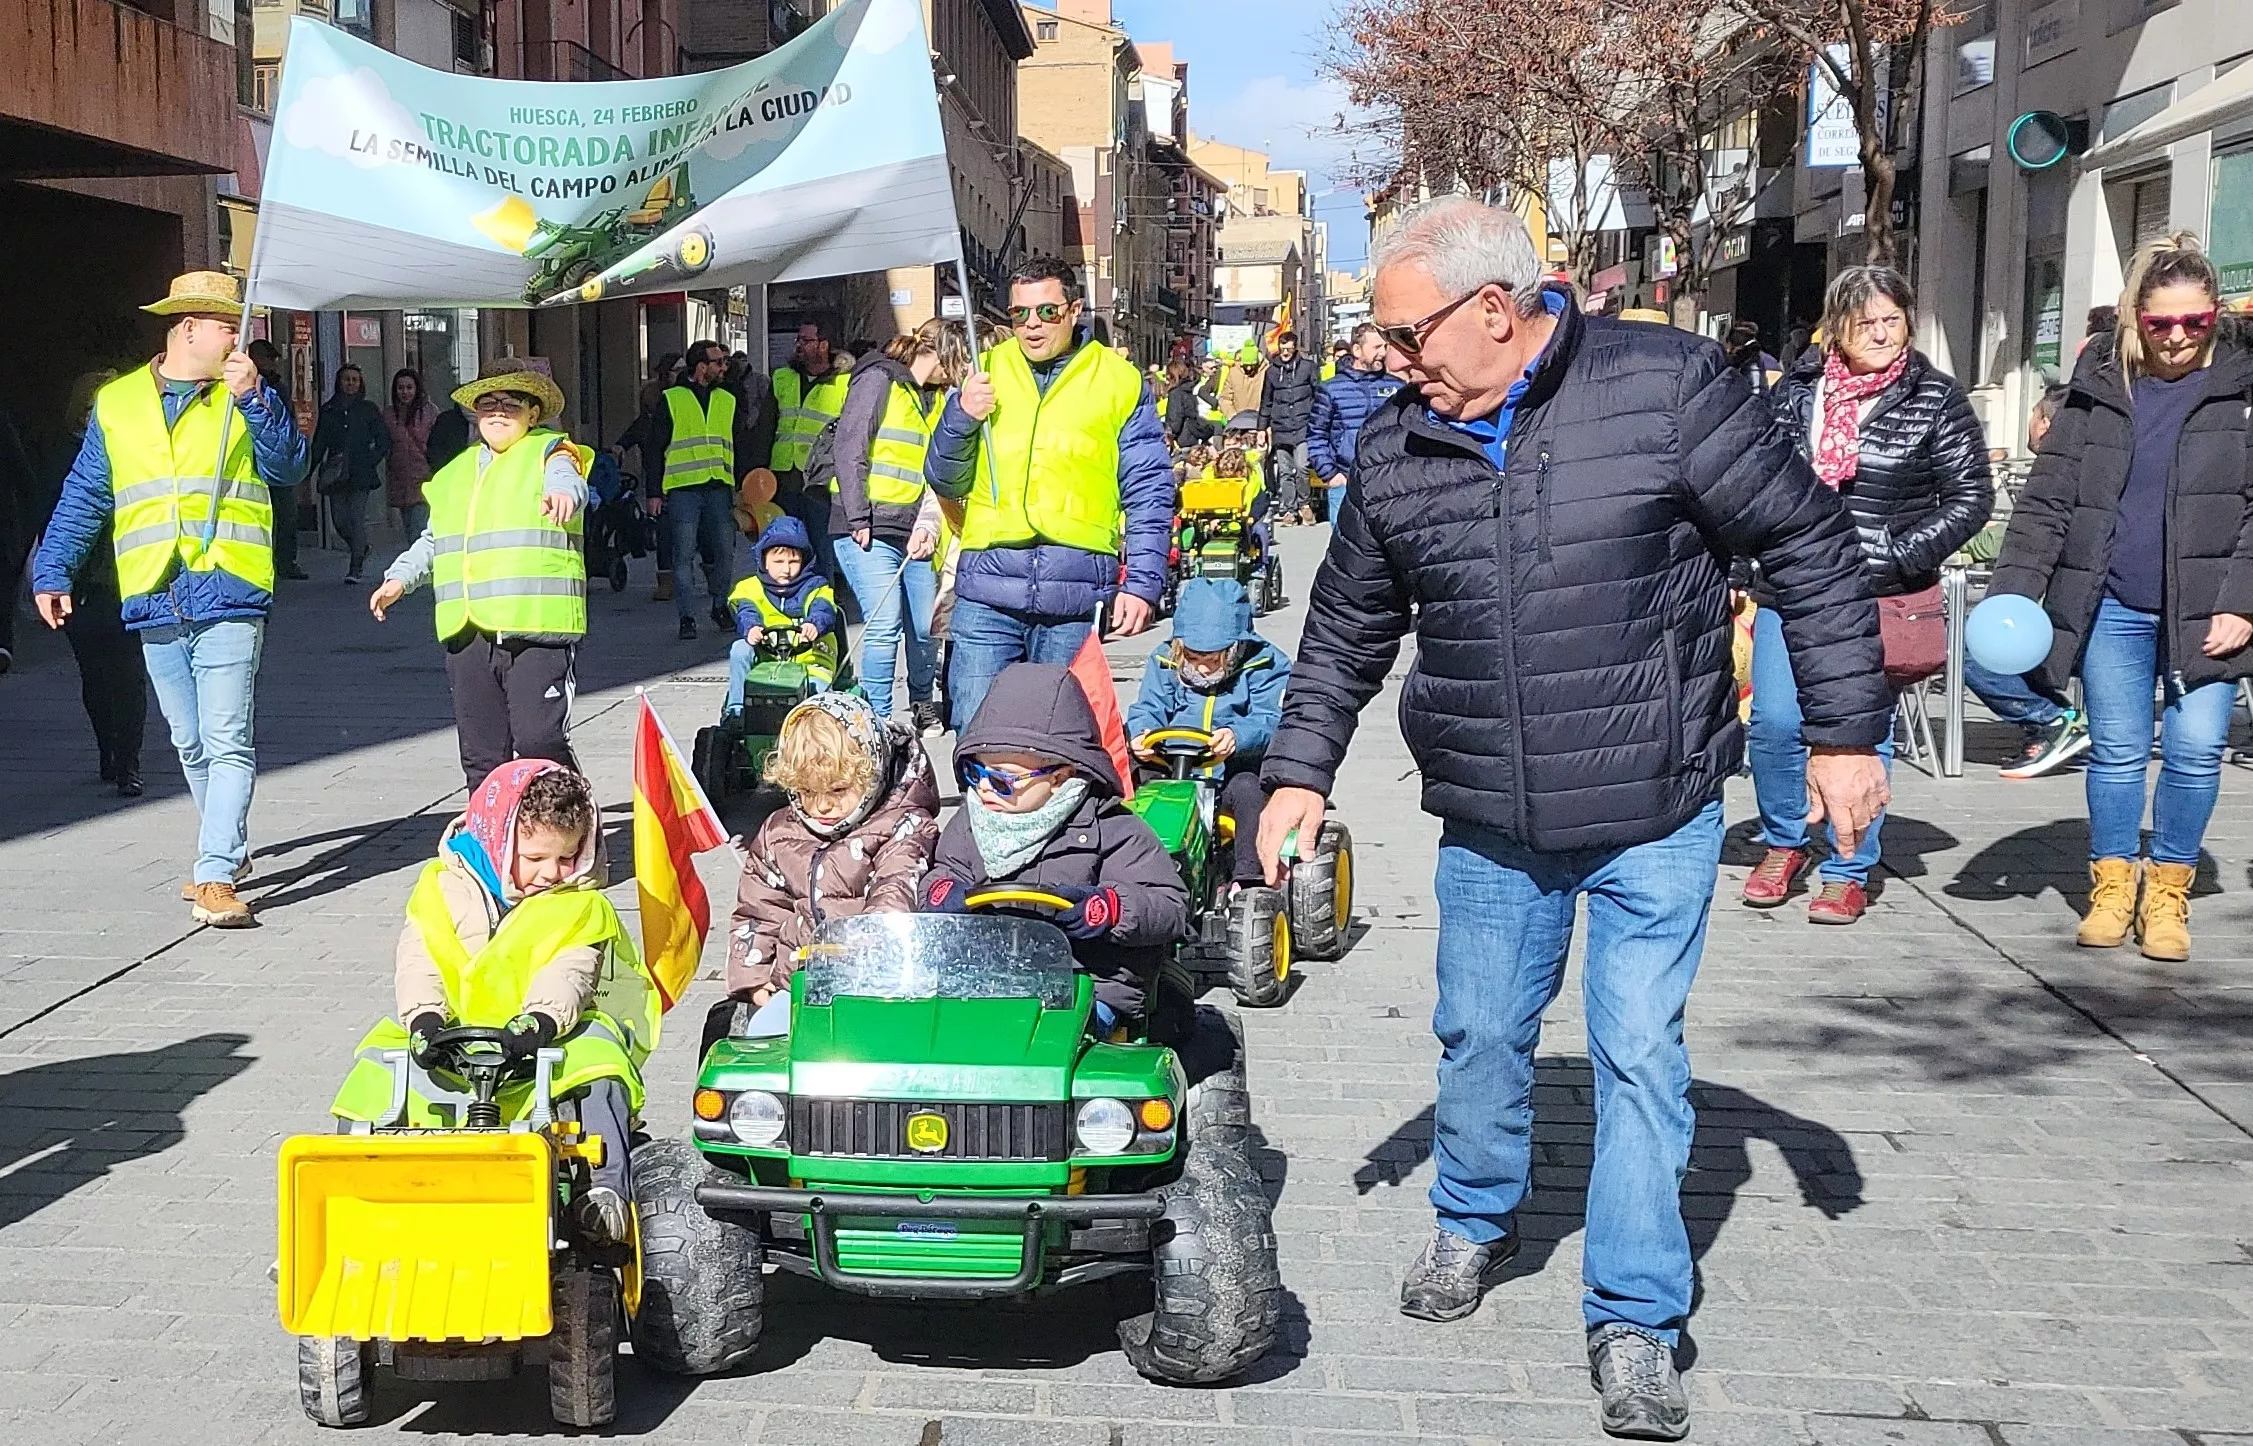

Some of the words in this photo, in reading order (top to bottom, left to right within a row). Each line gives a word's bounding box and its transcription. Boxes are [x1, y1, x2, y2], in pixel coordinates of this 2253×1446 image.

[350, 129, 378, 155] LA
[387, 139, 479, 181] SEMILLA
[484, 166, 523, 194] DEL
[530, 174, 616, 199] CAMPO
[624, 125, 717, 189] ALIMA
[726, 106, 754, 131] LA
[761, 82, 853, 122] CIUDAD
[420, 112, 635, 168] TRACTORADA
[648, 77, 769, 156] INFANL
[510, 107, 586, 128] HUESCA,
[593, 108, 614, 125] 24
[622, 98, 698, 124] FEBRERO
